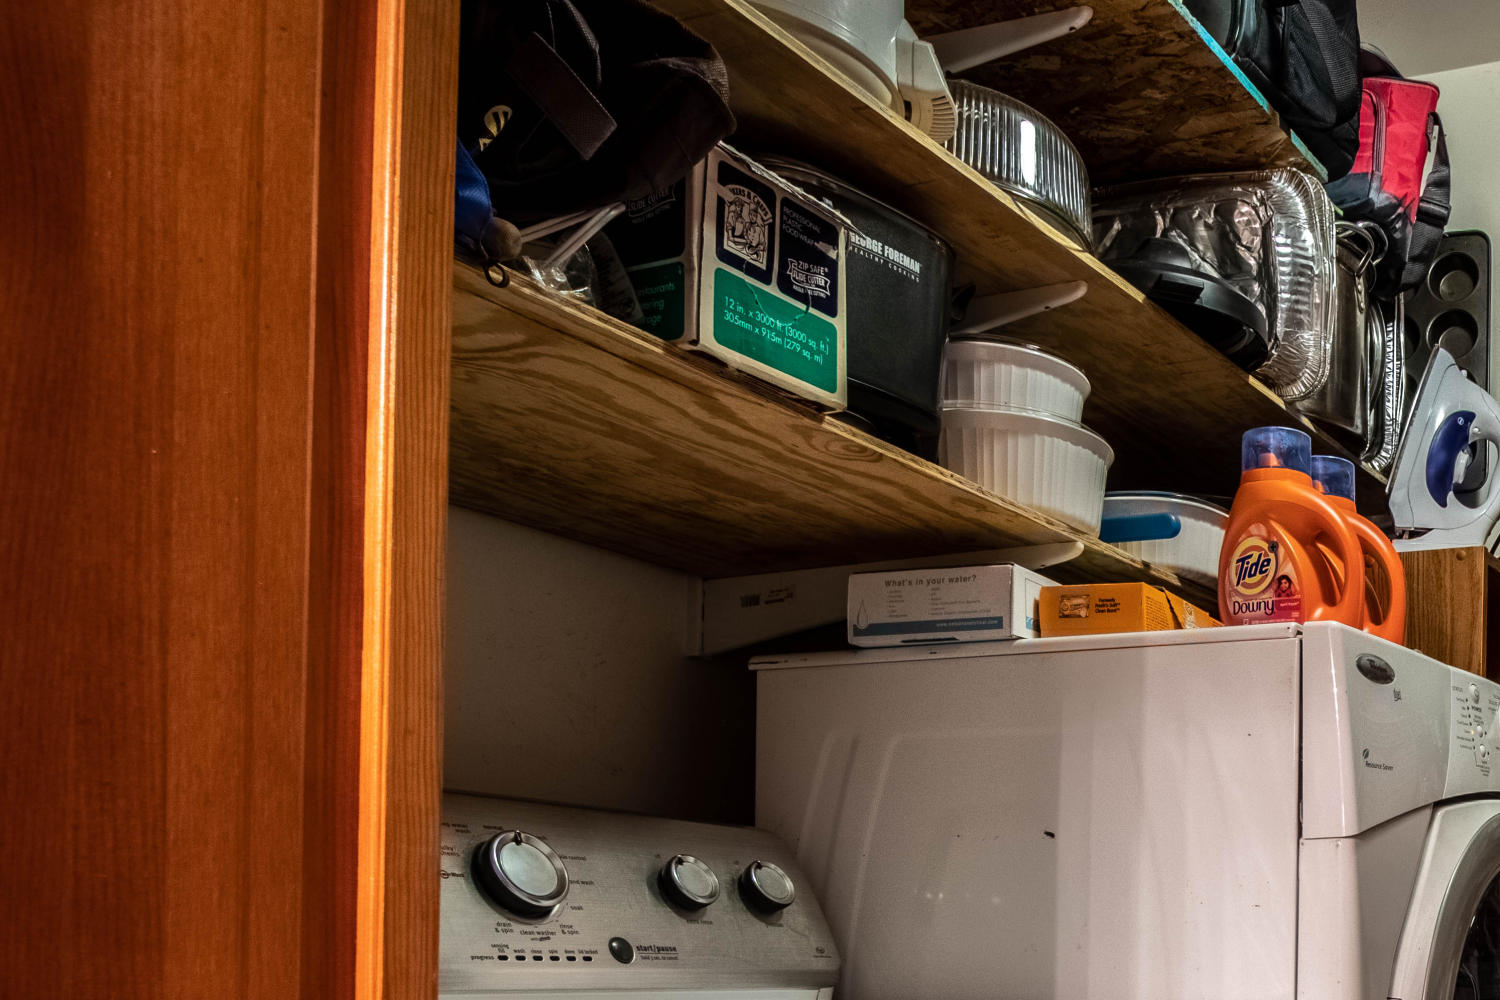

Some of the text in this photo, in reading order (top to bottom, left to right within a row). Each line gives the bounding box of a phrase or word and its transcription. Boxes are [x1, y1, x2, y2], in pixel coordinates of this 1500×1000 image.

[849, 231, 920, 274] GEORGE FOREMAN
[798, 261, 809, 271] ZIP
[807, 275, 826, 287] CUTTER
[725, 296, 735, 310] 12
[737, 302, 746, 315] in.
[755, 311, 775, 329] 3000
[785, 324, 807, 342] (3000
[724, 310, 753, 331] 305mm
[784, 338, 801, 353] (279
[814, 354, 823, 365] m)
[885, 575, 977, 587] What's in your water?
[1236, 552, 1272, 587] Tide
[1233, 600, 1275, 616] Downy
